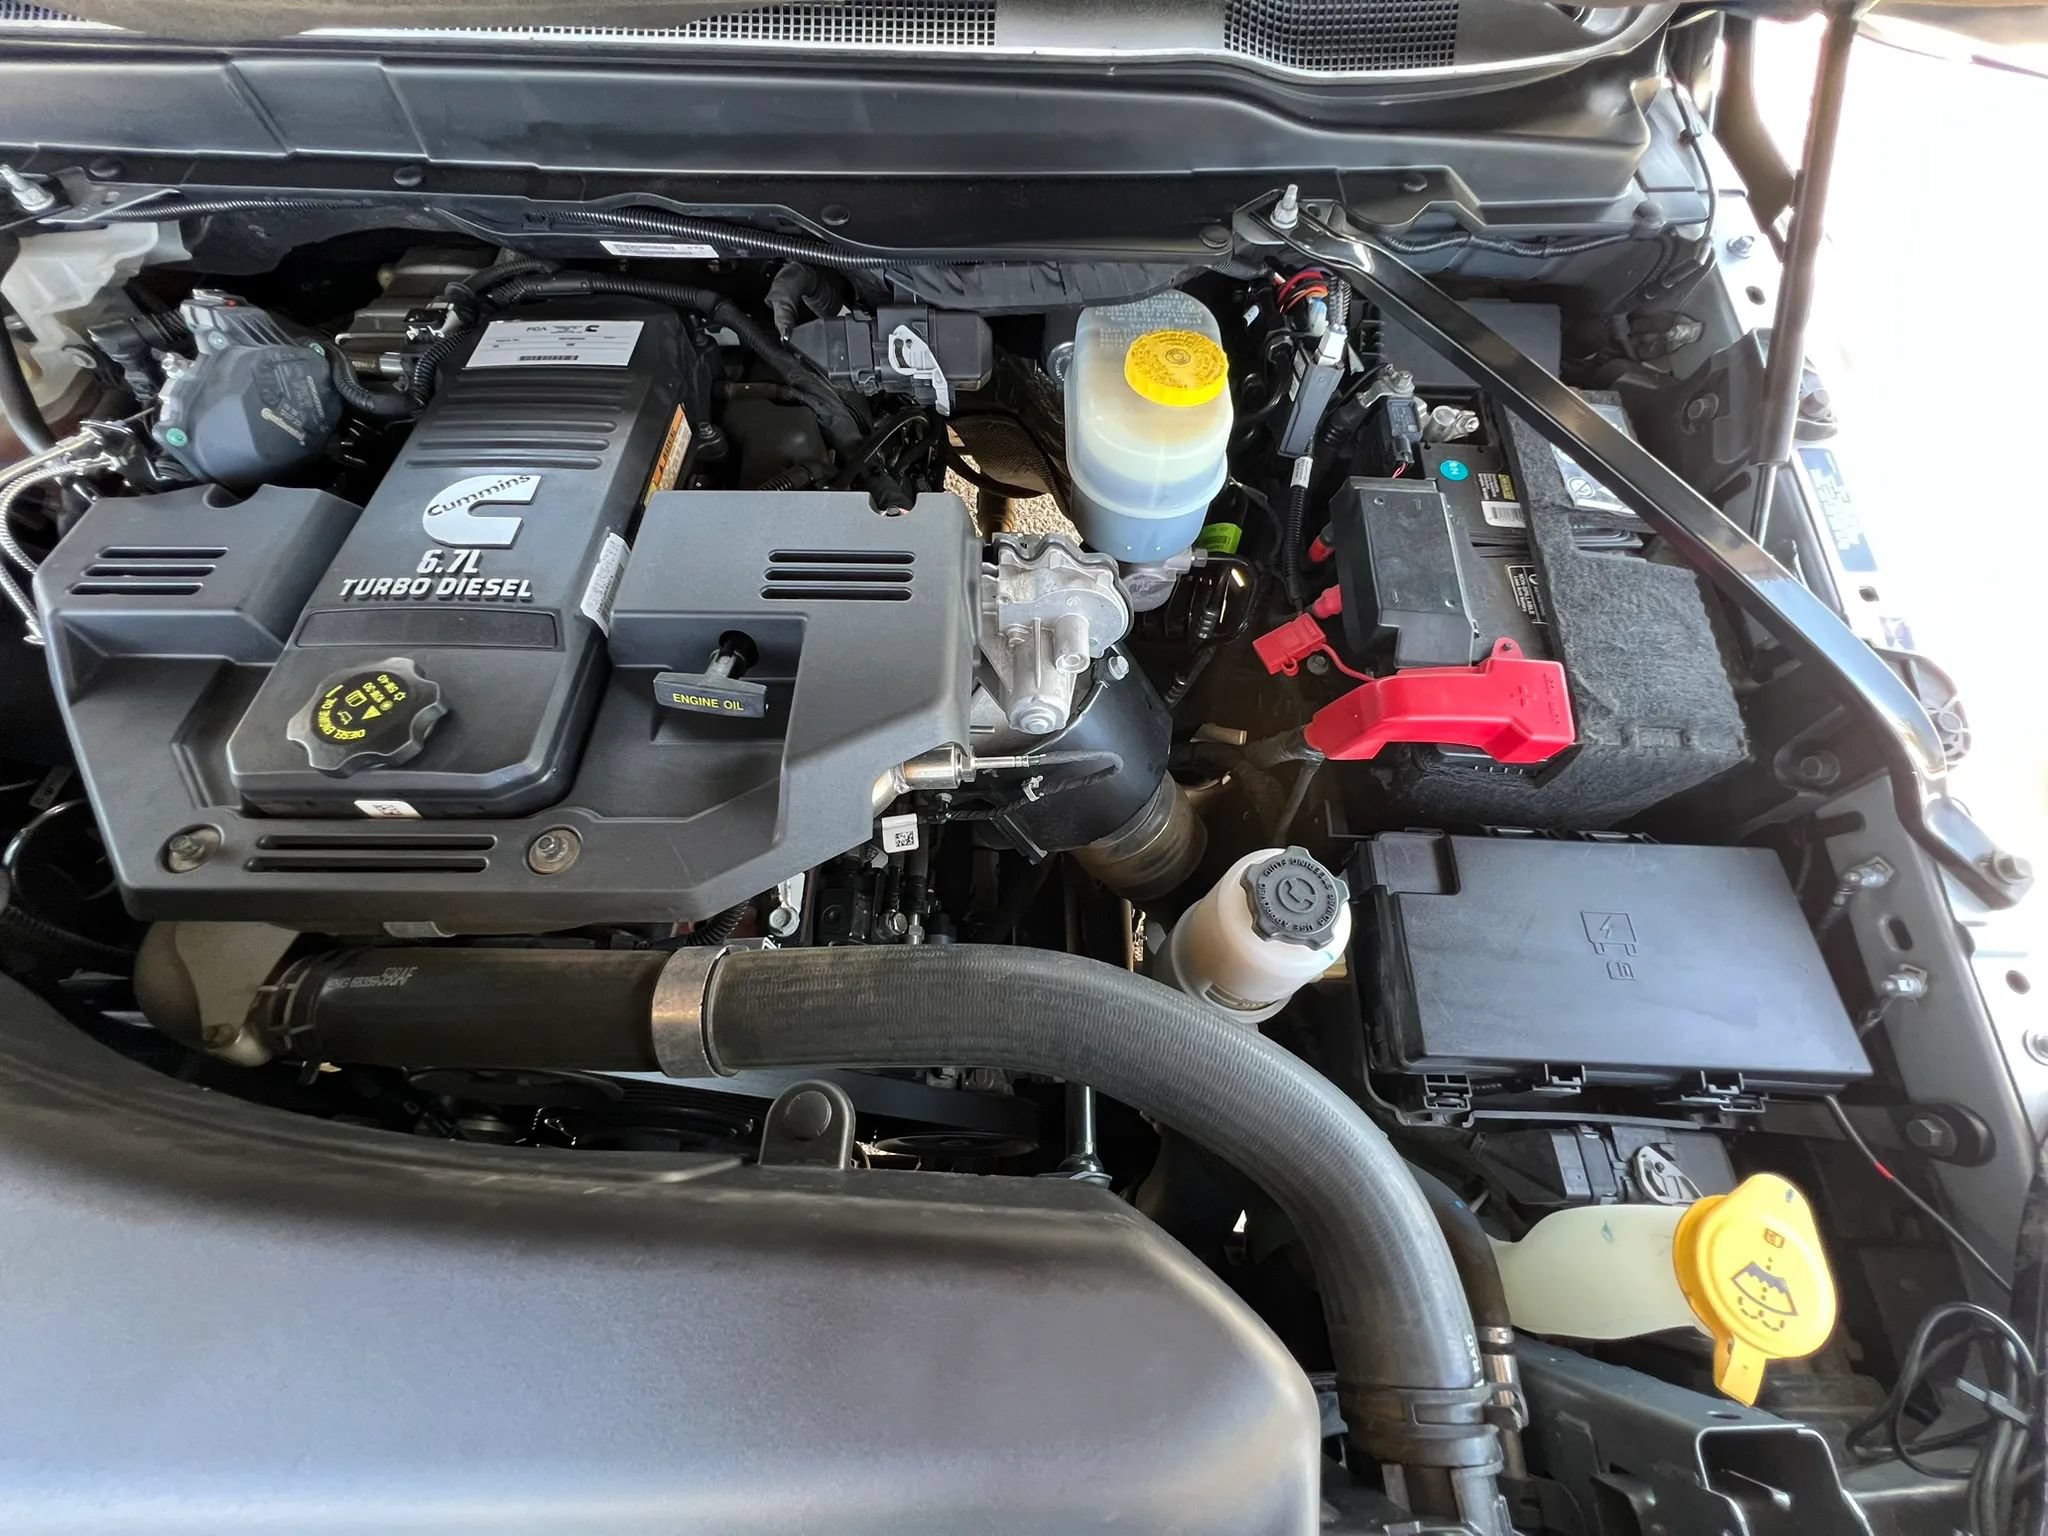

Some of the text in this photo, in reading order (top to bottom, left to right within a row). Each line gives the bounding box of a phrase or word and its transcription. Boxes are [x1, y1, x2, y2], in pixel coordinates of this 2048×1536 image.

[427, 474, 531, 516] Cummins
[416, 549, 481, 574] 6.7L
[340, 577, 533, 598] TURBO DIESEL
[672, 692, 744, 711] ENGINE OIL
